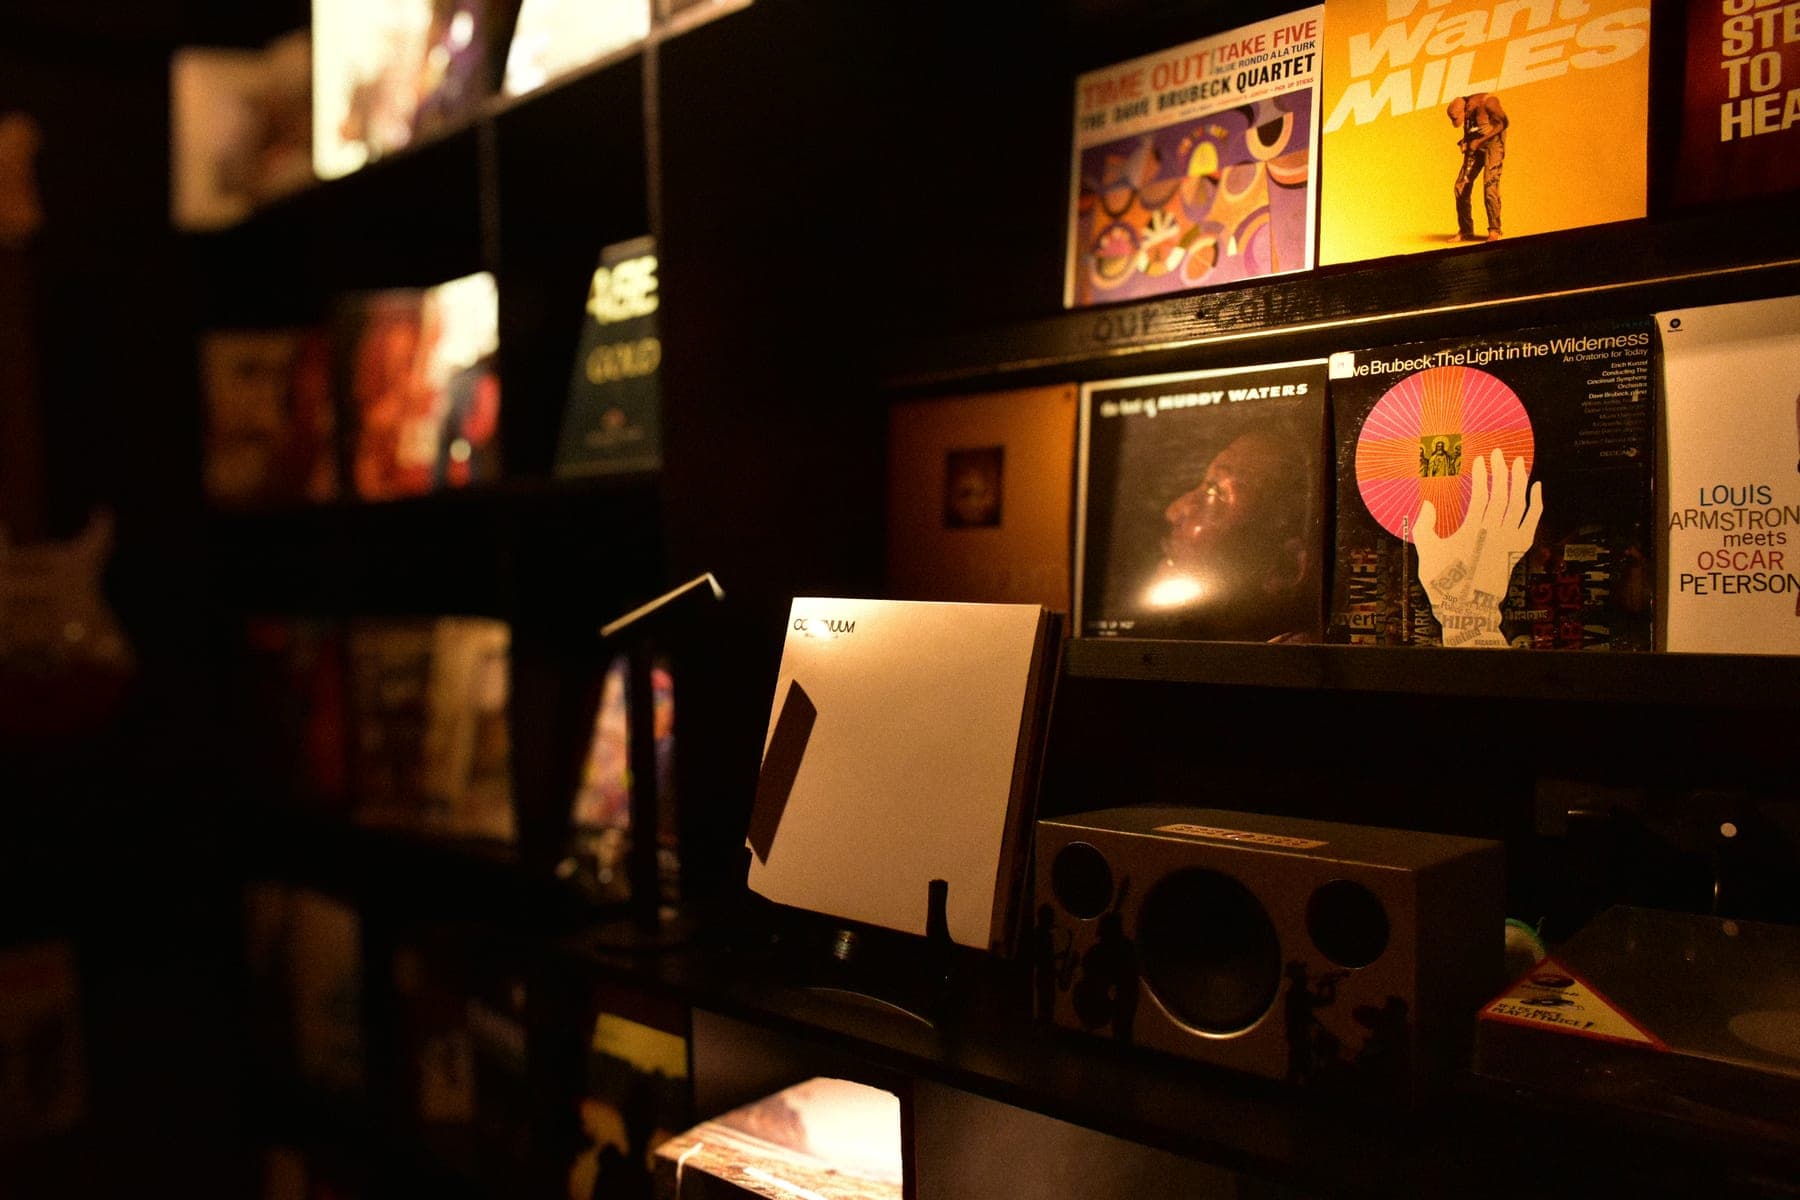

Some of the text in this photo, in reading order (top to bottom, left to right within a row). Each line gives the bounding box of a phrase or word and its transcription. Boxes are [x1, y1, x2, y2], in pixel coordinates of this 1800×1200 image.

[1216, 20, 1317, 62] TAKE FIVE
[1349, 0, 1591, 78] Want
[1238, 53, 1268, 68] RONDO
[1270, 51, 1277, 60] A
[1278, 47, 1290, 58] LA
[1291, 40, 1316, 55] TURK
[1084, 71, 1144, 110] TIME
[1152, 51, 1209, 92] OUT
[1157, 75, 1231, 111] BRUBECK
[1236, 53, 1316, 93] QUARTET
[1322, 7, 1650, 135] MILES
[1721, 51, 1782, 98] TO
[1466, 346, 1504, 366] Light
[1506, 345, 1520, 359] in
[1522, 342, 1549, 358] the
[1550, 332, 1649, 355] Wilderness
[1563, 348, 1648, 363] An Oratorio for Today
[1158, 390, 1224, 410] MUDDY
[1228, 383, 1308, 402] WATERS
[1700, 484, 1772, 507] LOUIS
[1669, 504, 1800, 532] ARMSTRON
[1723, 530, 1787, 547] meets
[1697, 549, 1784, 571] OSCAR
[1680, 572, 1800, 595] PETERSON
